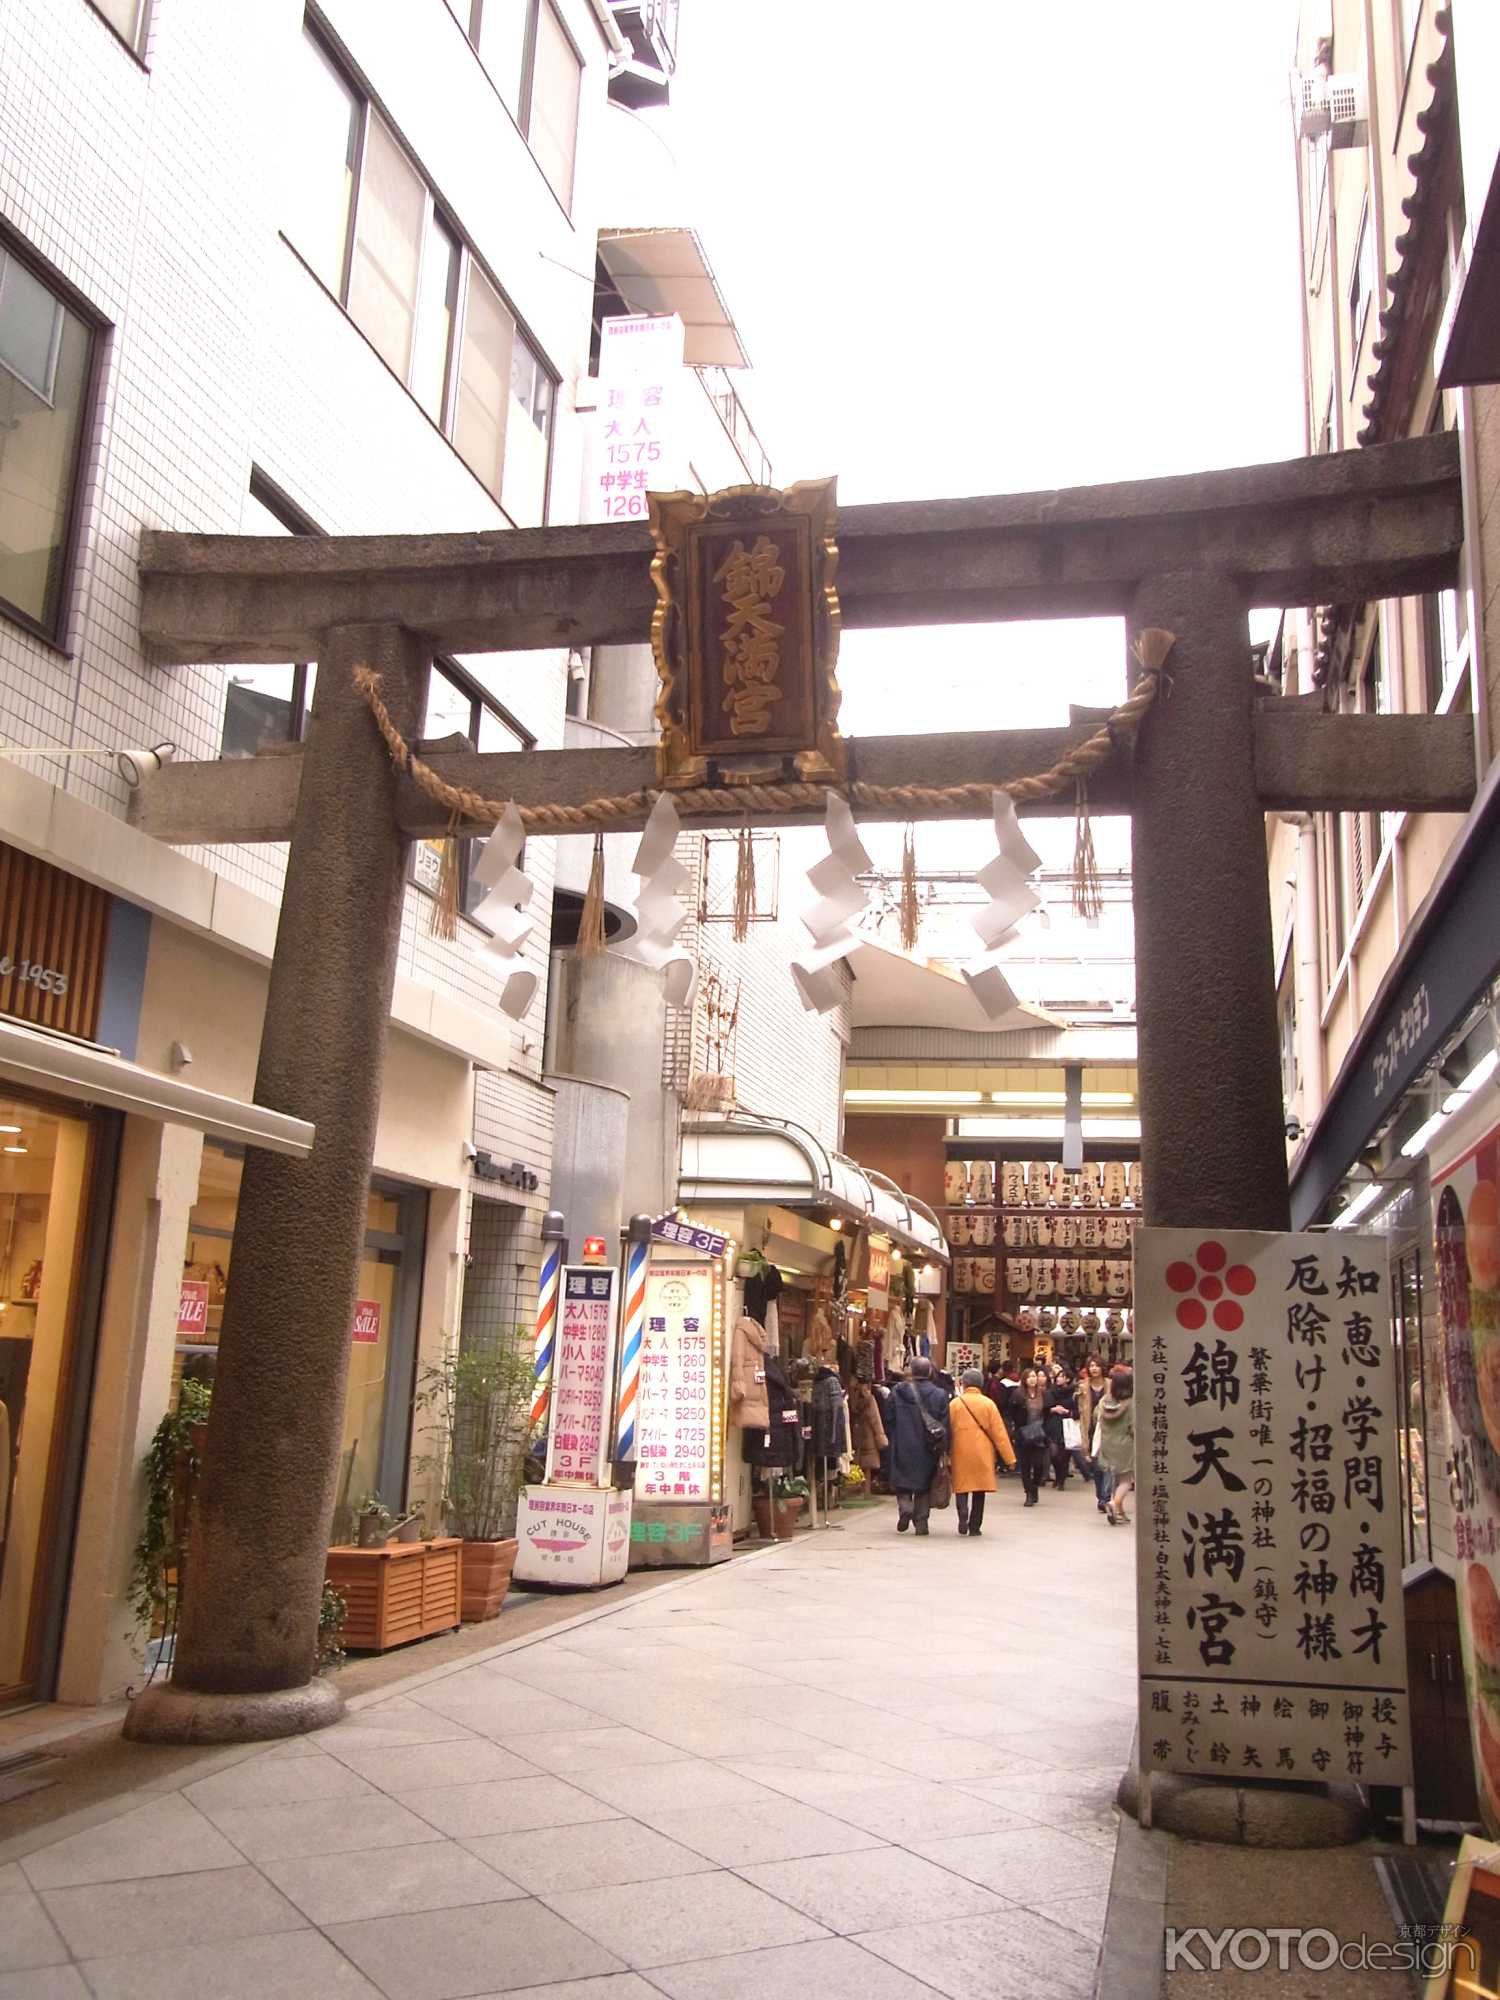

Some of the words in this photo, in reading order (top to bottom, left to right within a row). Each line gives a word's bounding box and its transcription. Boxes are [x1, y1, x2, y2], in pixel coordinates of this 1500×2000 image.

[607, 441, 661, 464] 1575
[600, 469, 648, 491] 中学生
[712, 534, 786, 736] 錦天満宮
[19, 959, 69, 995] 1953
[568, 1276, 609, 1295] 理容
[180, 1301, 206, 1321] ALE
[565, 1302, 588, 1320] 大人
[590, 1304, 608, 1320] 1575
[354, 1315, 378, 1334] SALE
[563, 1323, 587, 1340] 中学生
[589, 1325, 606, 1340] 1260
[649, 1317, 700, 1332] 理容
[561, 1344, 585, 1360] 小人
[644, 1336, 668, 1350] 大人
[677, 1336, 706, 1350] 1575
[642, 1353, 669, 1367] 中学生
[677, 1354, 706, 1367] 1260
[585, 1365, 605, 1381] 5040
[642, 1371, 668, 1383] 小人
[683, 1370, 705, 1384] 945
[642, 1388, 669, 1401] パーマ
[675, 1387, 706, 1401] 5040
[675, 1407, 706, 1420] 5250
[581, 1415, 602, 1432] 4725
[580, 1435, 599, 1452] 2940
[674, 1428, 705, 1441] 4725
[674, 1444, 706, 1458] 2940
[1285, 1254, 1343, 1662] 厄除け・招福の神様
[1335, 1255, 1388, 1665] 知恵・学問・商才
[645, 1483, 701, 1495] 年中無休
[1180, 1339, 1248, 1668] 錦天満宮
[526, 1519, 547, 1536] CUT
[556, 1518, 592, 1541] HOUSE
[1152, 1690, 1173, 1762] 腹帯
[1181, 1690, 1199, 1764] おみくじ
[1210, 1693, 1231, 1765] 土鈴
[1240, 1695, 1262, 1768] 神矢
[1273, 1697, 1295, 1770] 絵馬
[1308, 1698, 1331, 1772] 御守
[1371, 1697, 1398, 1759] 授与
[1343, 1700, 1365, 1775] 御神符
